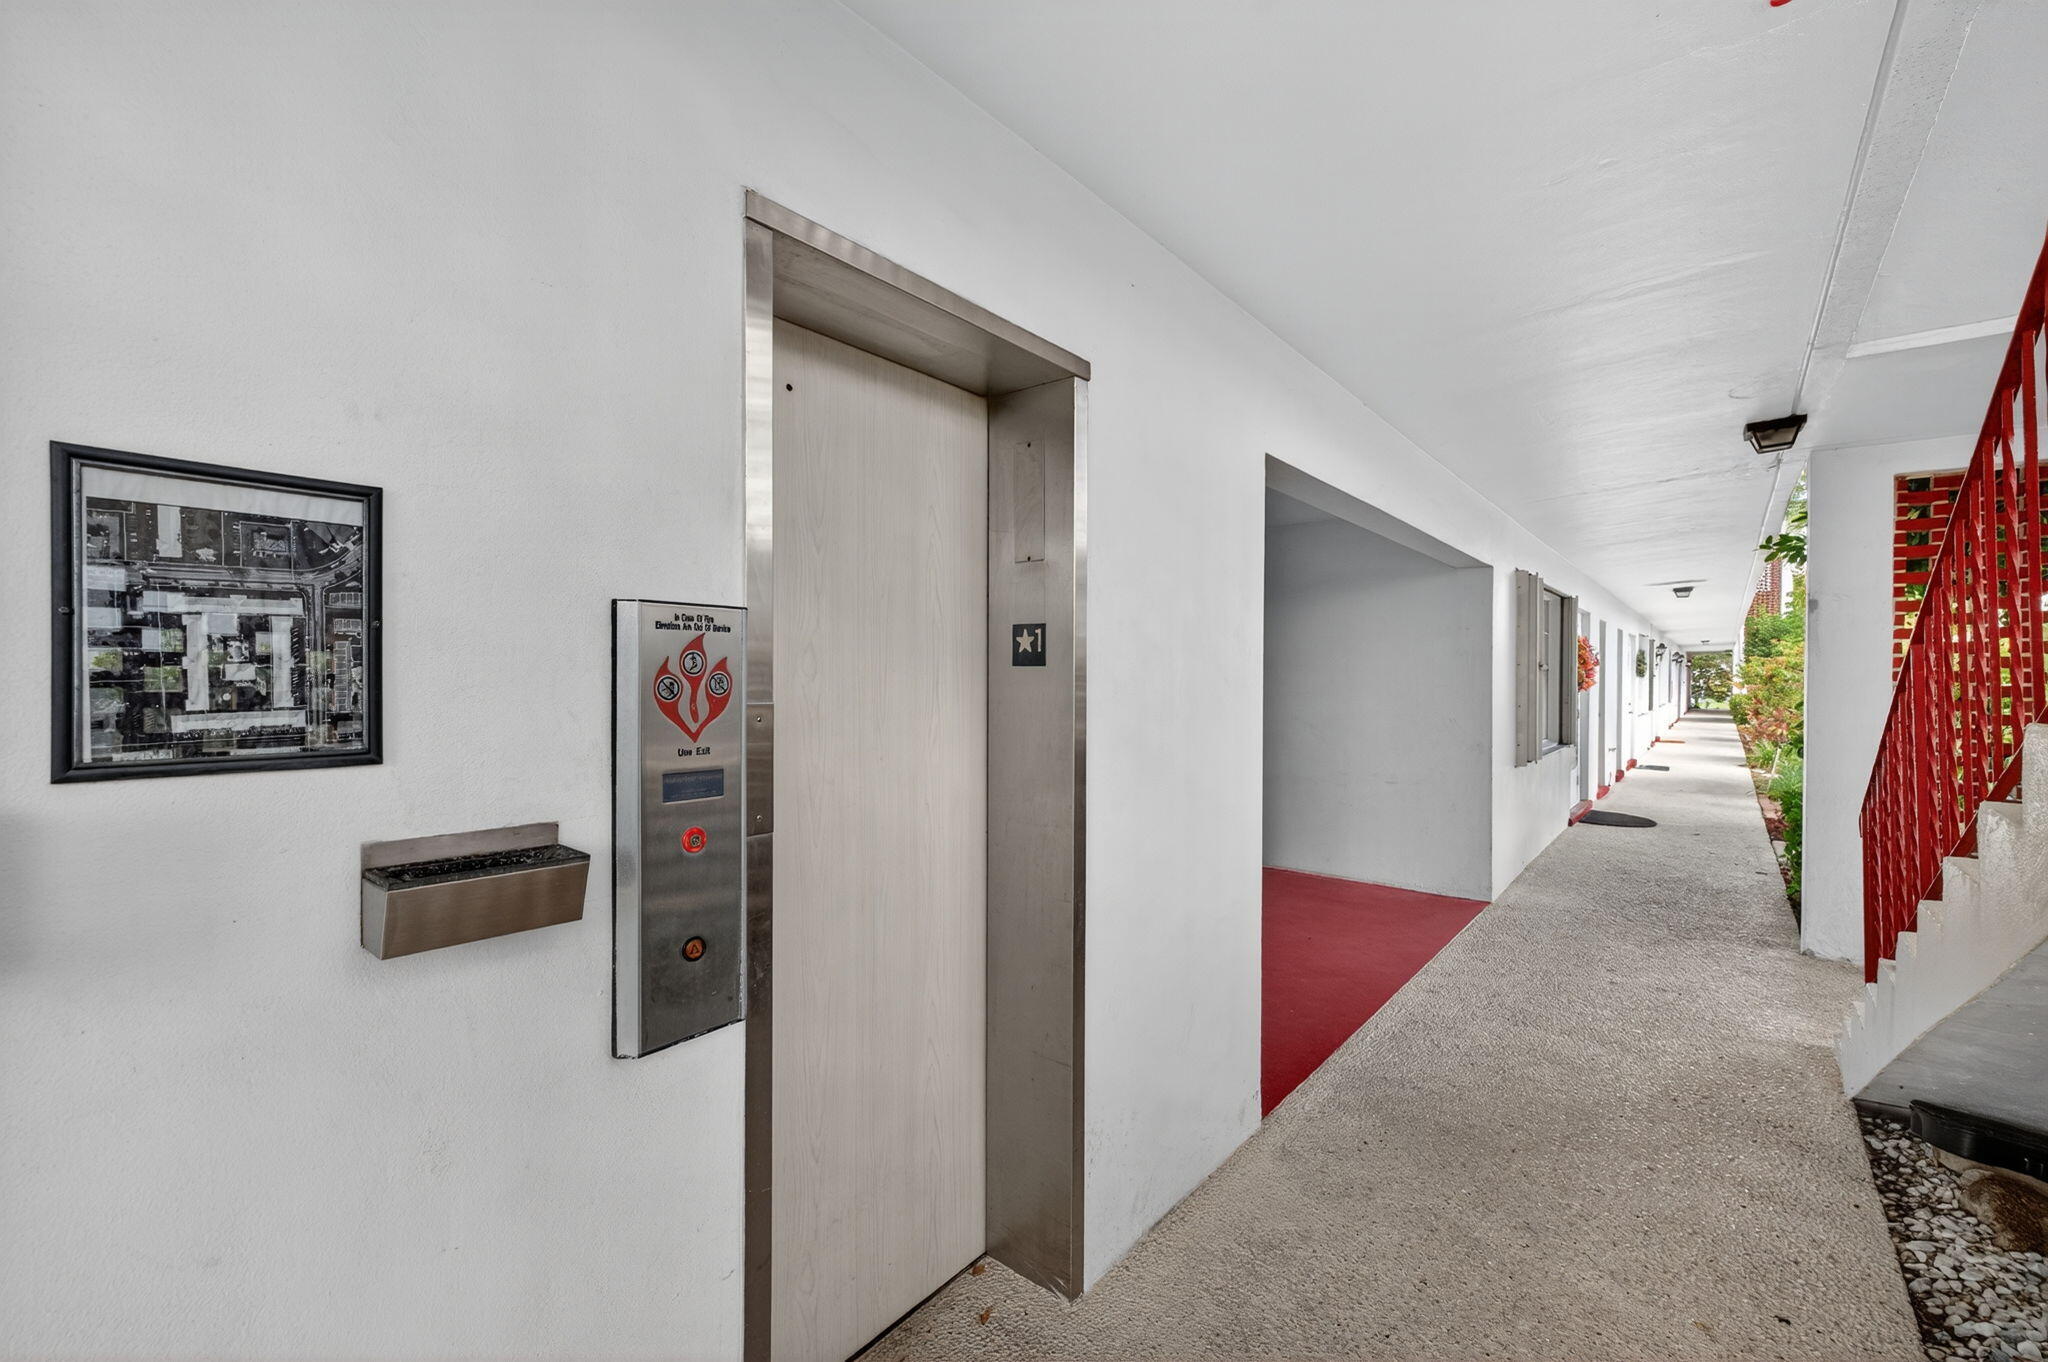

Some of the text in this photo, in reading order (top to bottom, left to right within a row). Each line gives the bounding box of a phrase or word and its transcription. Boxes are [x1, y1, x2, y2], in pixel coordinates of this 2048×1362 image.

[681, 614, 694, 622] Case
[704, 615, 714, 623] Fire
[1035, 628, 1041, 652] 1
[678, 747, 710, 757] Use Exit
